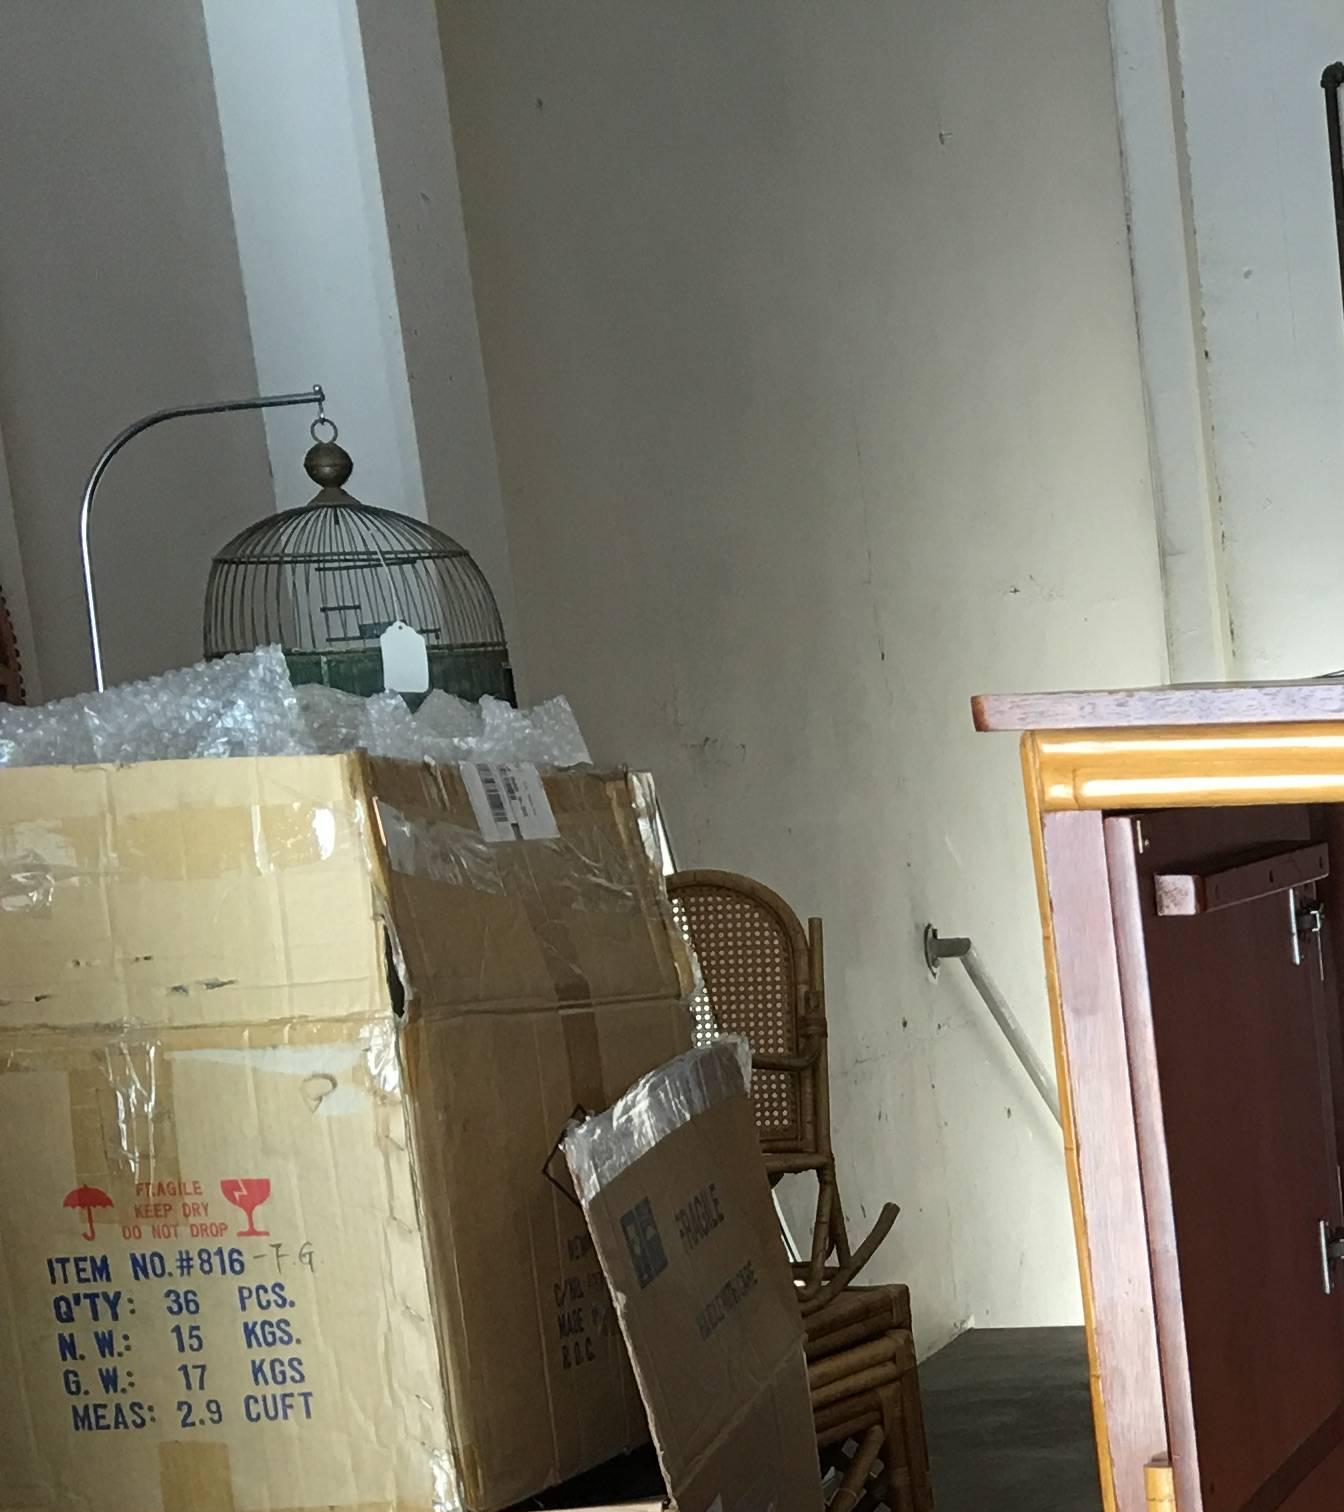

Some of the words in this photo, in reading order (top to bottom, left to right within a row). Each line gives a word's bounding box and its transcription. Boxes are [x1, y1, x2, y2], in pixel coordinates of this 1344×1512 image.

[136, 1181, 204, 1198] FRAGILE
[133, 1203, 174, 1219] KEEP
[182, 1202, 210, 1218] DRY
[122, 1224, 142, 1240] DO
[152, 1223, 179, 1239] NOT
[190, 1222, 229, 1238] DROP
[47, 1253, 113, 1285] ITEM
[53, 1289, 137, 1323] Q'TY:
[164, 1289, 201, 1317] 36
[238, 1281, 296, 1313] PCS.
[170, 1324, 204, 1354] 15
[242, 1318, 302, 1350] KGS.
[177, 1363, 208, 1392] 17
[250, 1357, 306, 1387] KGS
[71, 1401, 157, 1432] MEAS:
[175, 1398, 224, 1429] 2.9
[243, 1390, 314, 1424] CUFT
